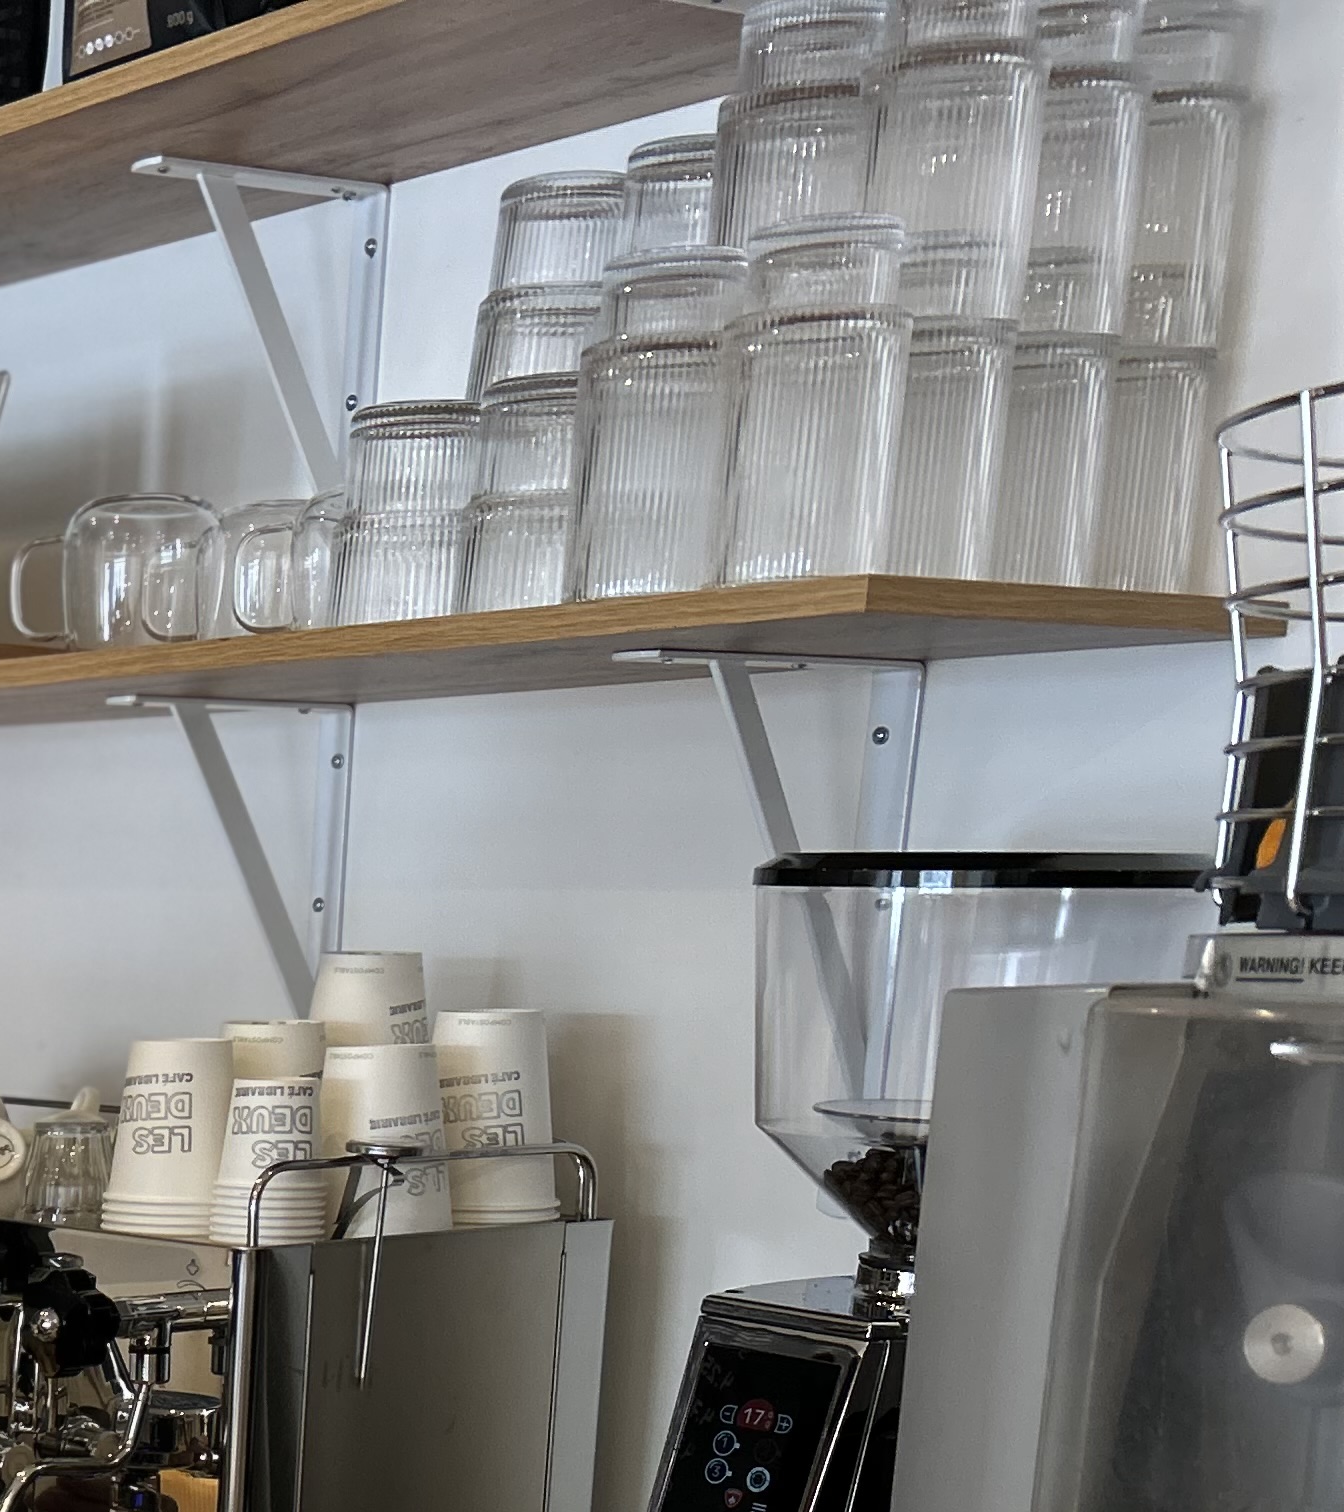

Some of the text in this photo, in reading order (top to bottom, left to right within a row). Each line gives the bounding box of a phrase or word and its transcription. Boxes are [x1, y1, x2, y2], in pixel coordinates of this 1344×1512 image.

[1239, 956, 1344, 976] WARNING! KEE
[162, 1072, 194, 1087] CAFÉ
[491, 1071, 520, 1085] CAFÉ
[288, 1086, 314, 1099] CAFÉ
[232, 1105, 313, 1135] DEUX
[132, 1125, 193, 1155] LES
[251, 1140, 313, 1169] LES
